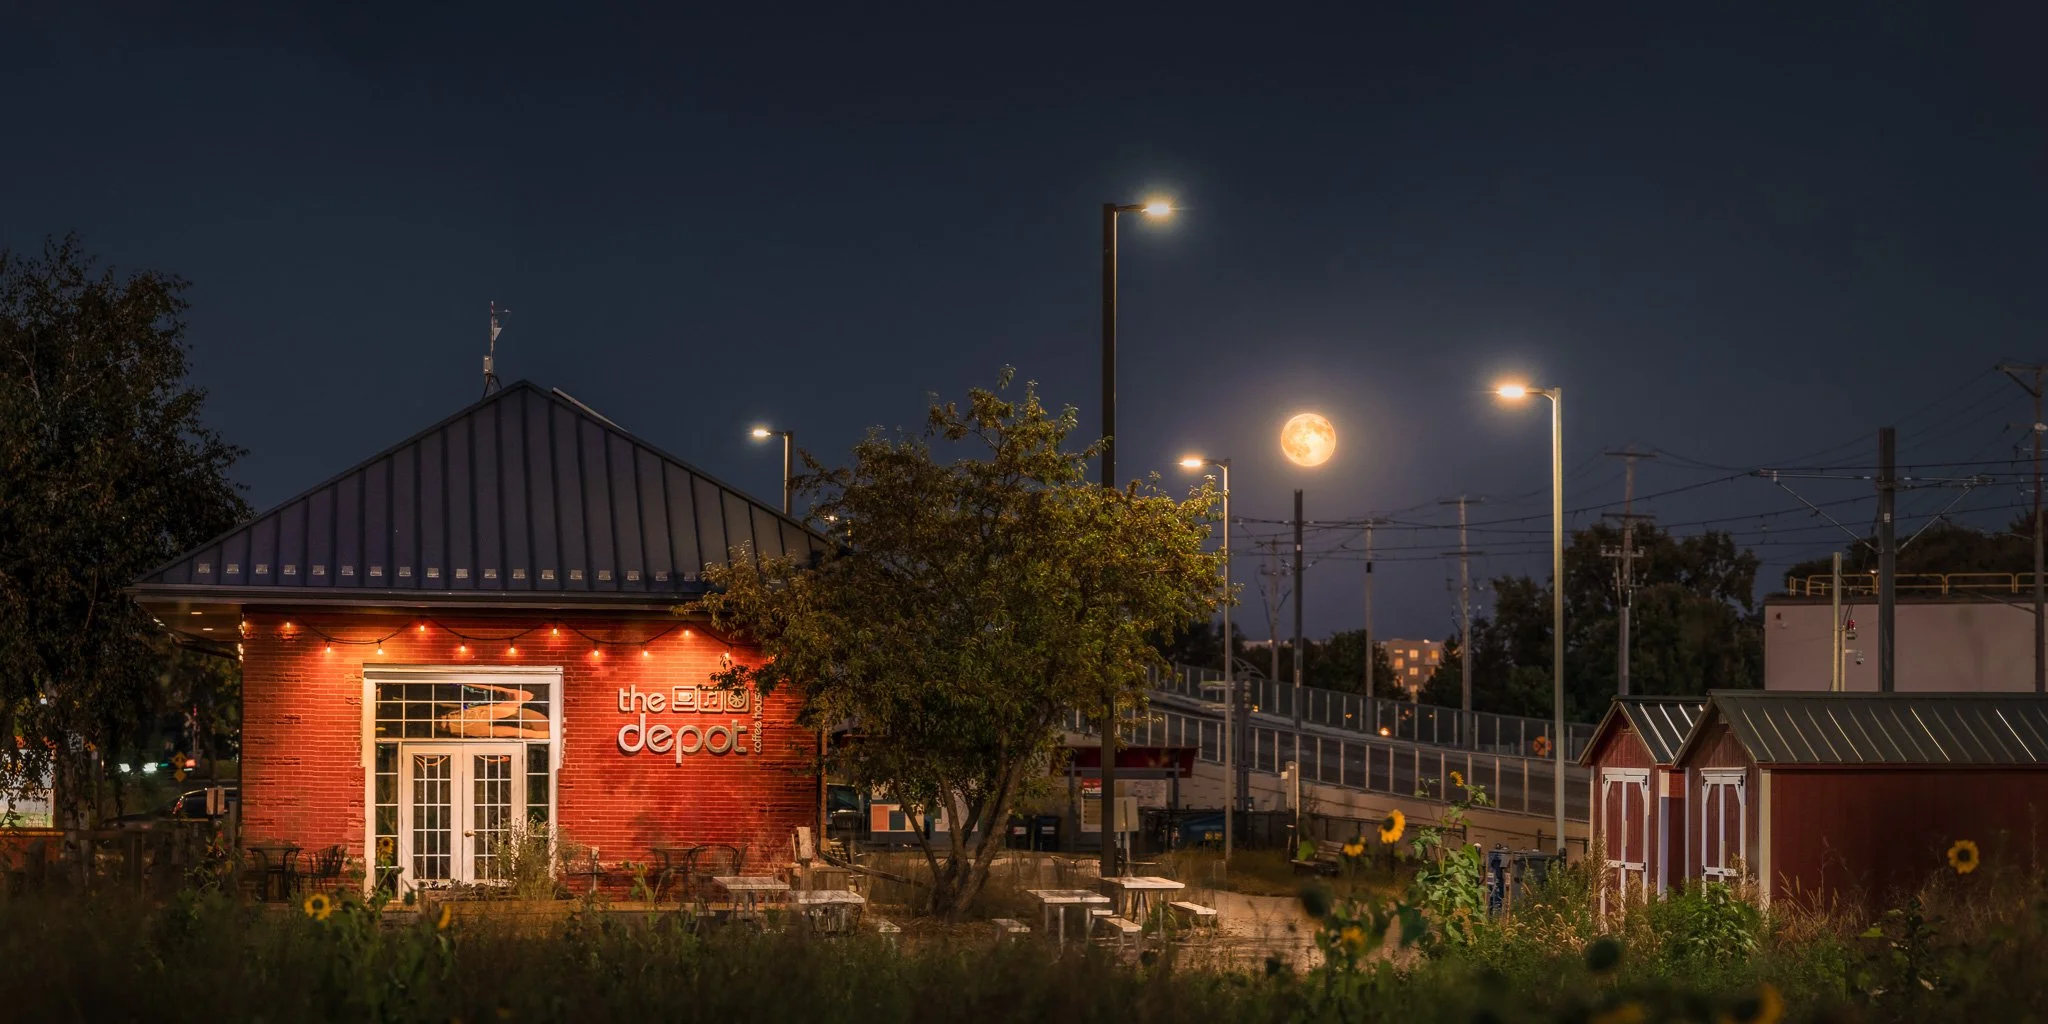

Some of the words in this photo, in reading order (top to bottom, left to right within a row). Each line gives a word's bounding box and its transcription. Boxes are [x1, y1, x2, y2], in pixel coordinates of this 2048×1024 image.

[618, 684, 666, 712] the
[752, 687, 763, 719] hous
[618, 713, 747, 763] depot
[752, 721, 763, 753] coffee
